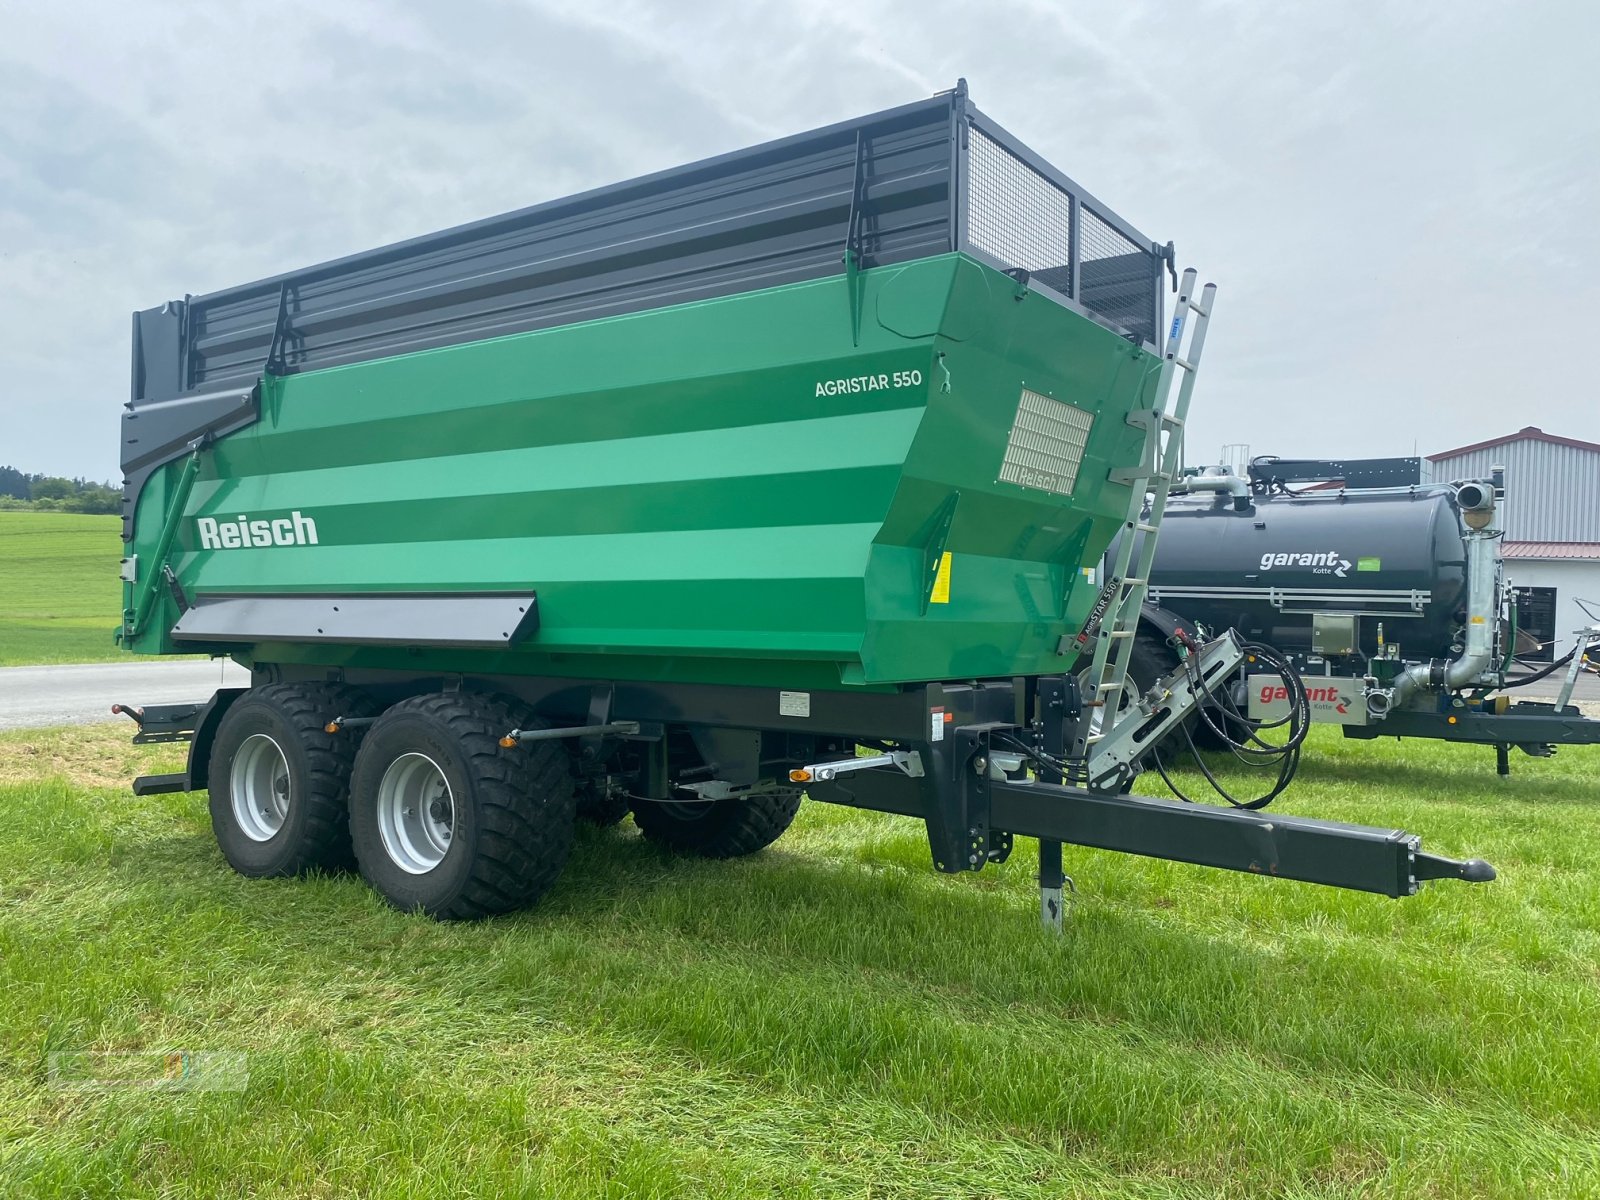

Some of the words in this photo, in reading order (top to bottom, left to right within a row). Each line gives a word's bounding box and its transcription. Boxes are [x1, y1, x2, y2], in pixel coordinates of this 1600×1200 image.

[815, 374, 889, 397] AGRISTAR
[892, 369, 922, 389] 550
[1018, 467, 1058, 491] Reisch
[197, 510, 319, 550] Reisch
[1260, 551, 1339, 570] garant
[1312, 567, 1332, 575] Kotte
[1104, 583, 1117, 599] 550
